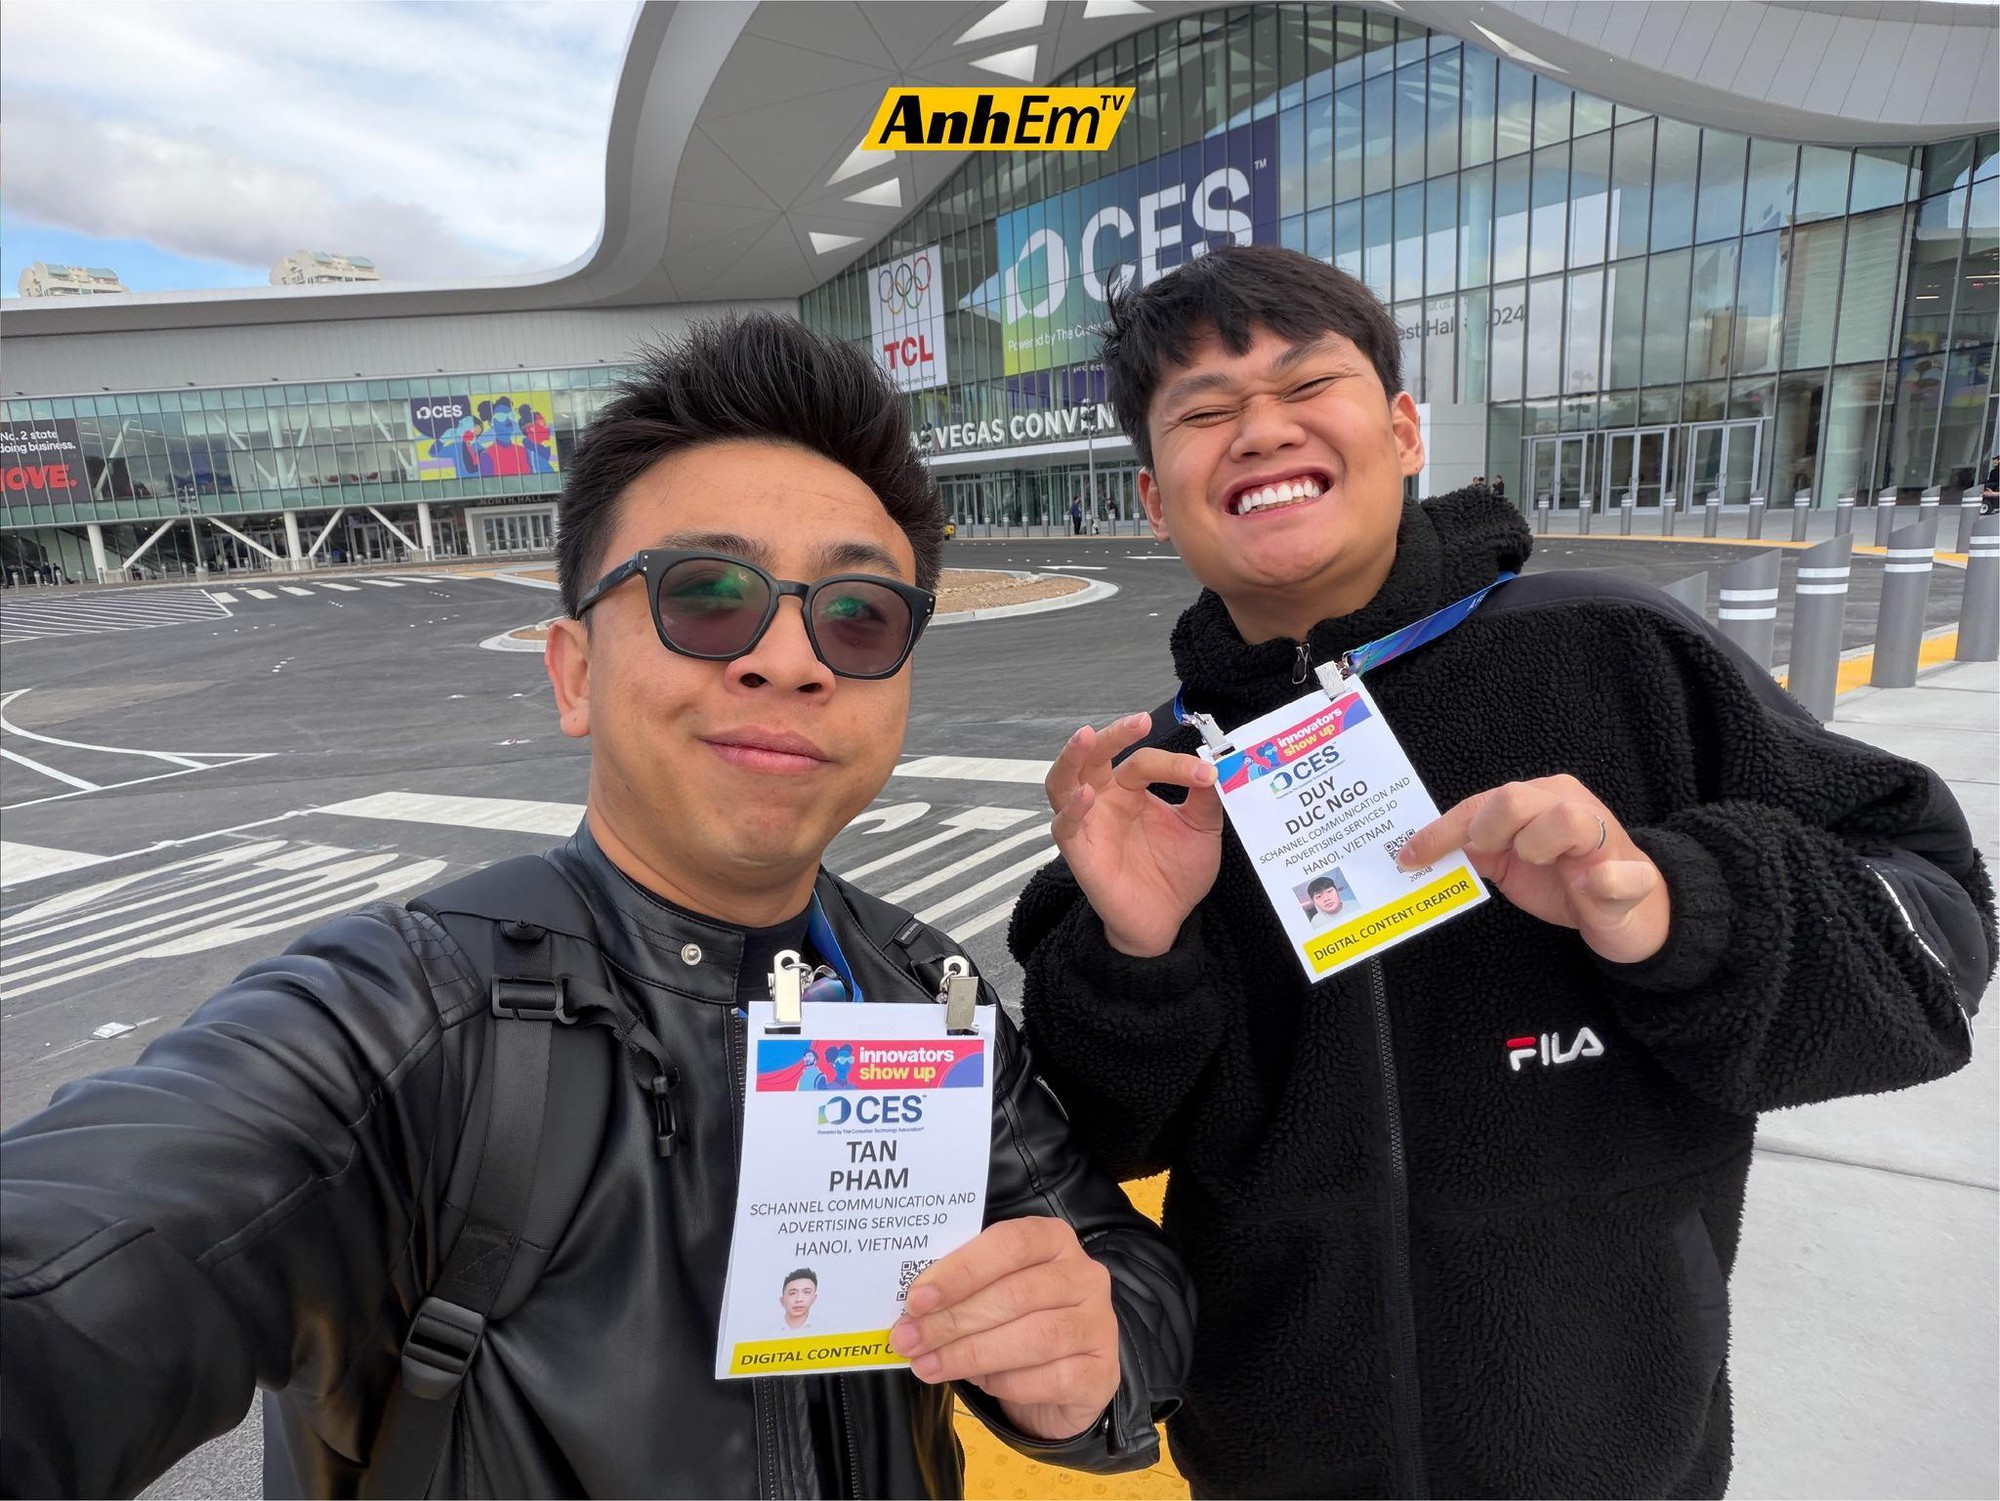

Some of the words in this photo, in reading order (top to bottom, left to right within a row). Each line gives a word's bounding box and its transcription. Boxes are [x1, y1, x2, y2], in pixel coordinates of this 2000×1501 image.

[1081, 167, 1252, 301] CES
[1008, 335, 1044, 352] Powered
[1044, 333, 1056, 346] by
[1056, 328, 1073, 342] The
[1397, 322, 1421, 341] est
[883, 333, 934, 370] TCL
[432, 404, 463, 419] CES
[20, 430, 28, 440] 2
[30, 430, 58, 440] state
[934, 418, 1005, 449] VEGAS
[1010, 402, 1116, 440] CONVEN
[28, 441, 76, 452] business.
[480, 496, 515, 505] NORTH
[517, 495, 545, 503] HALL
[1277, 708, 1343, 748] innovators
[1283, 734, 1317, 757] show
[1319, 724, 1336, 738] up
[1293, 745, 1340, 780] CES
[1298, 776, 1335, 808] DUY
[1259, 836, 1309, 864] SCHANNEL
[1308, 789, 1388, 840] COMMUNICATION
[1390, 777, 1410, 795] AND
[1284, 805, 1326, 835] DUC
[1326, 780, 1368, 813] NGO
[1284, 832, 1344, 867] ADVERTISING
[1345, 807, 1386, 836] SERVICES
[1385, 800, 1398, 812] JO
[1302, 851, 1344, 876] HANOI,
[1342, 819, 1395, 854] VIETNAM
[1313, 934, 1360, 961] DIGITAL
[1360, 906, 1414, 939] CONTENT
[1415, 880, 1470, 912] CREATOR
[859, 1047, 955, 1064] innovators
[1506, 1026, 1605, 1072] FILA
[859, 1064, 910, 1080] show
[913, 1066, 936, 1082] up
[856, 1094, 923, 1124] CES
[846, 1139, 897, 1163] TAN
[829, 1167, 909, 1192] PHAM
[750, 1200, 824, 1216] SCHANNEL
[827, 1194, 945, 1212] COMMUNICATION
[948, 1191, 976, 1205] AND
[778, 1218, 868, 1235] ADVERTISING
[871, 1214, 930, 1229] SERVICES
[933, 1212, 948, 1225] JO
[795, 1240, 852, 1257] HANOI,
[857, 1234, 929, 1252] VIETNAM
[741, 1351, 803, 1366] DIGITAL
[807, 1343, 882, 1360] CONTENT
